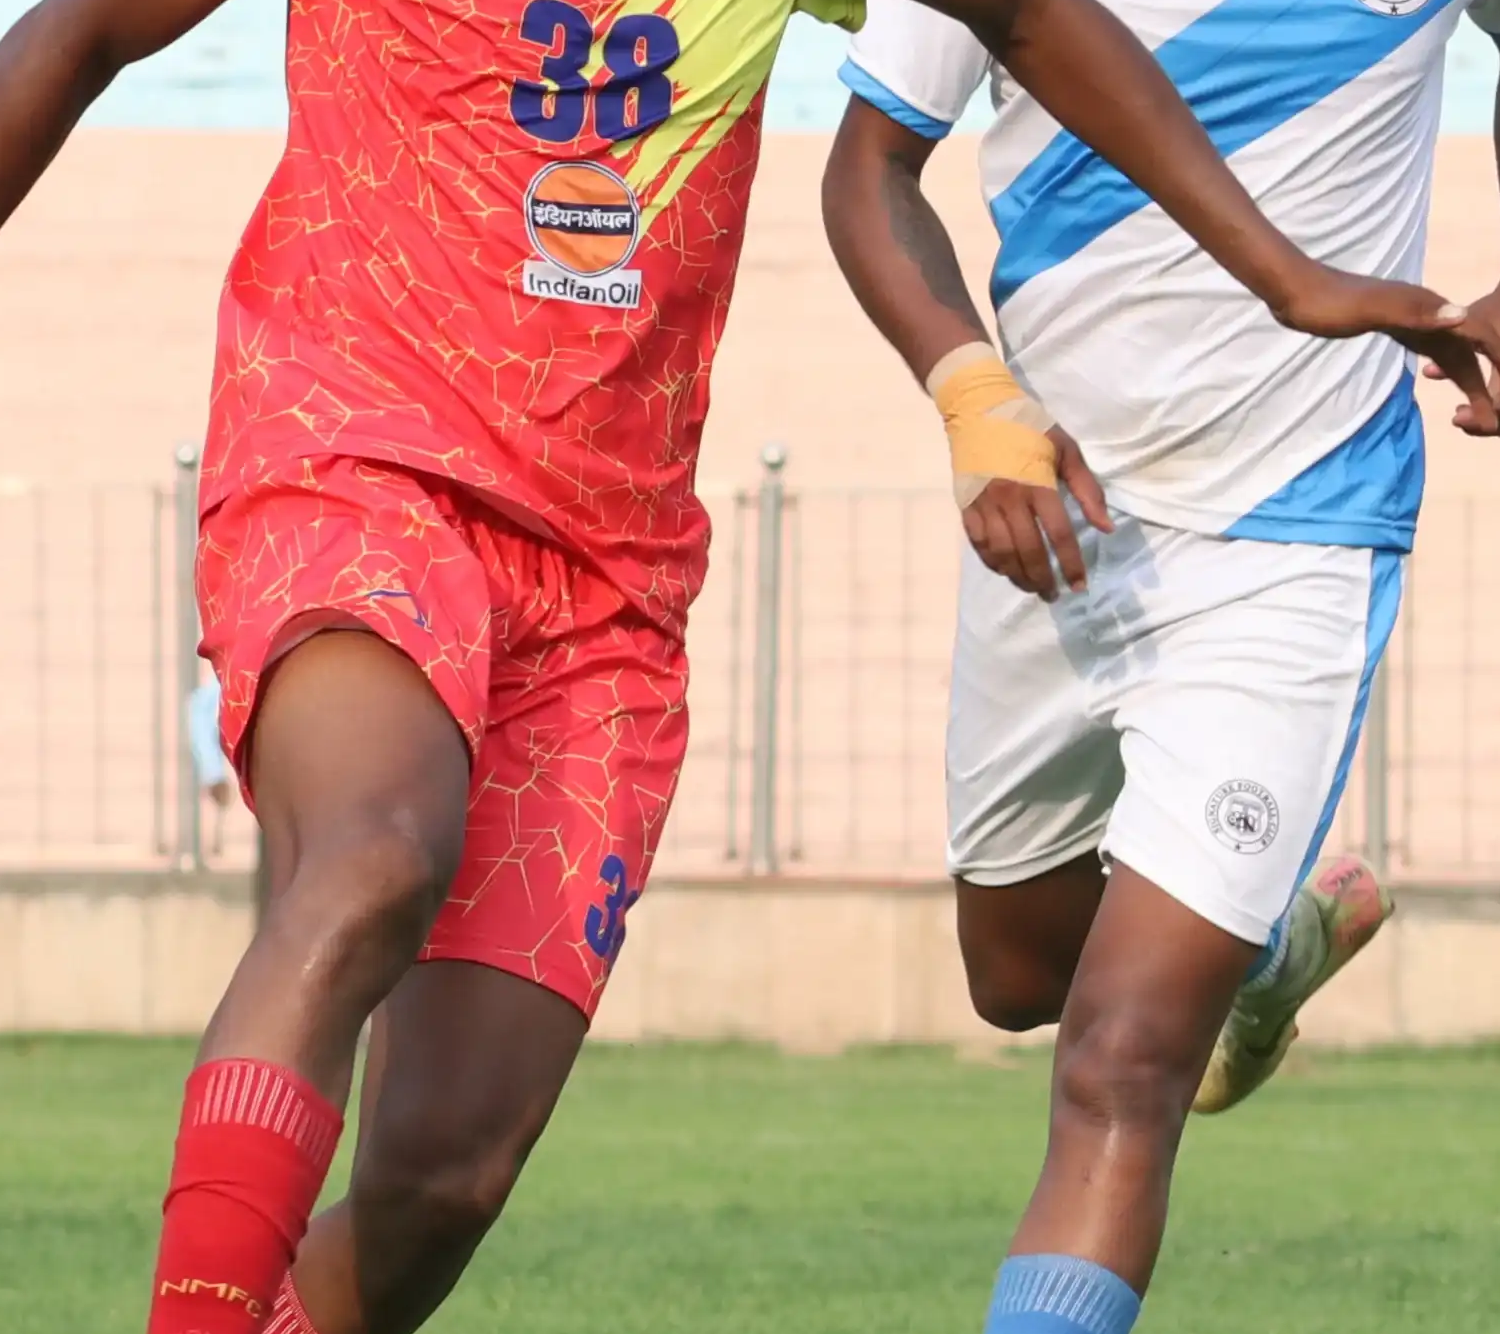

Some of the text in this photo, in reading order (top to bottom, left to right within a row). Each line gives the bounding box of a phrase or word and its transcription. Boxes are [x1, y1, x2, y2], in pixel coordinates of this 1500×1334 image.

[532, 203, 632, 229] इंडियनऑयल
[529, 273, 639, 305] IndianOil
[160, 1278, 261, 1318] NMFC
